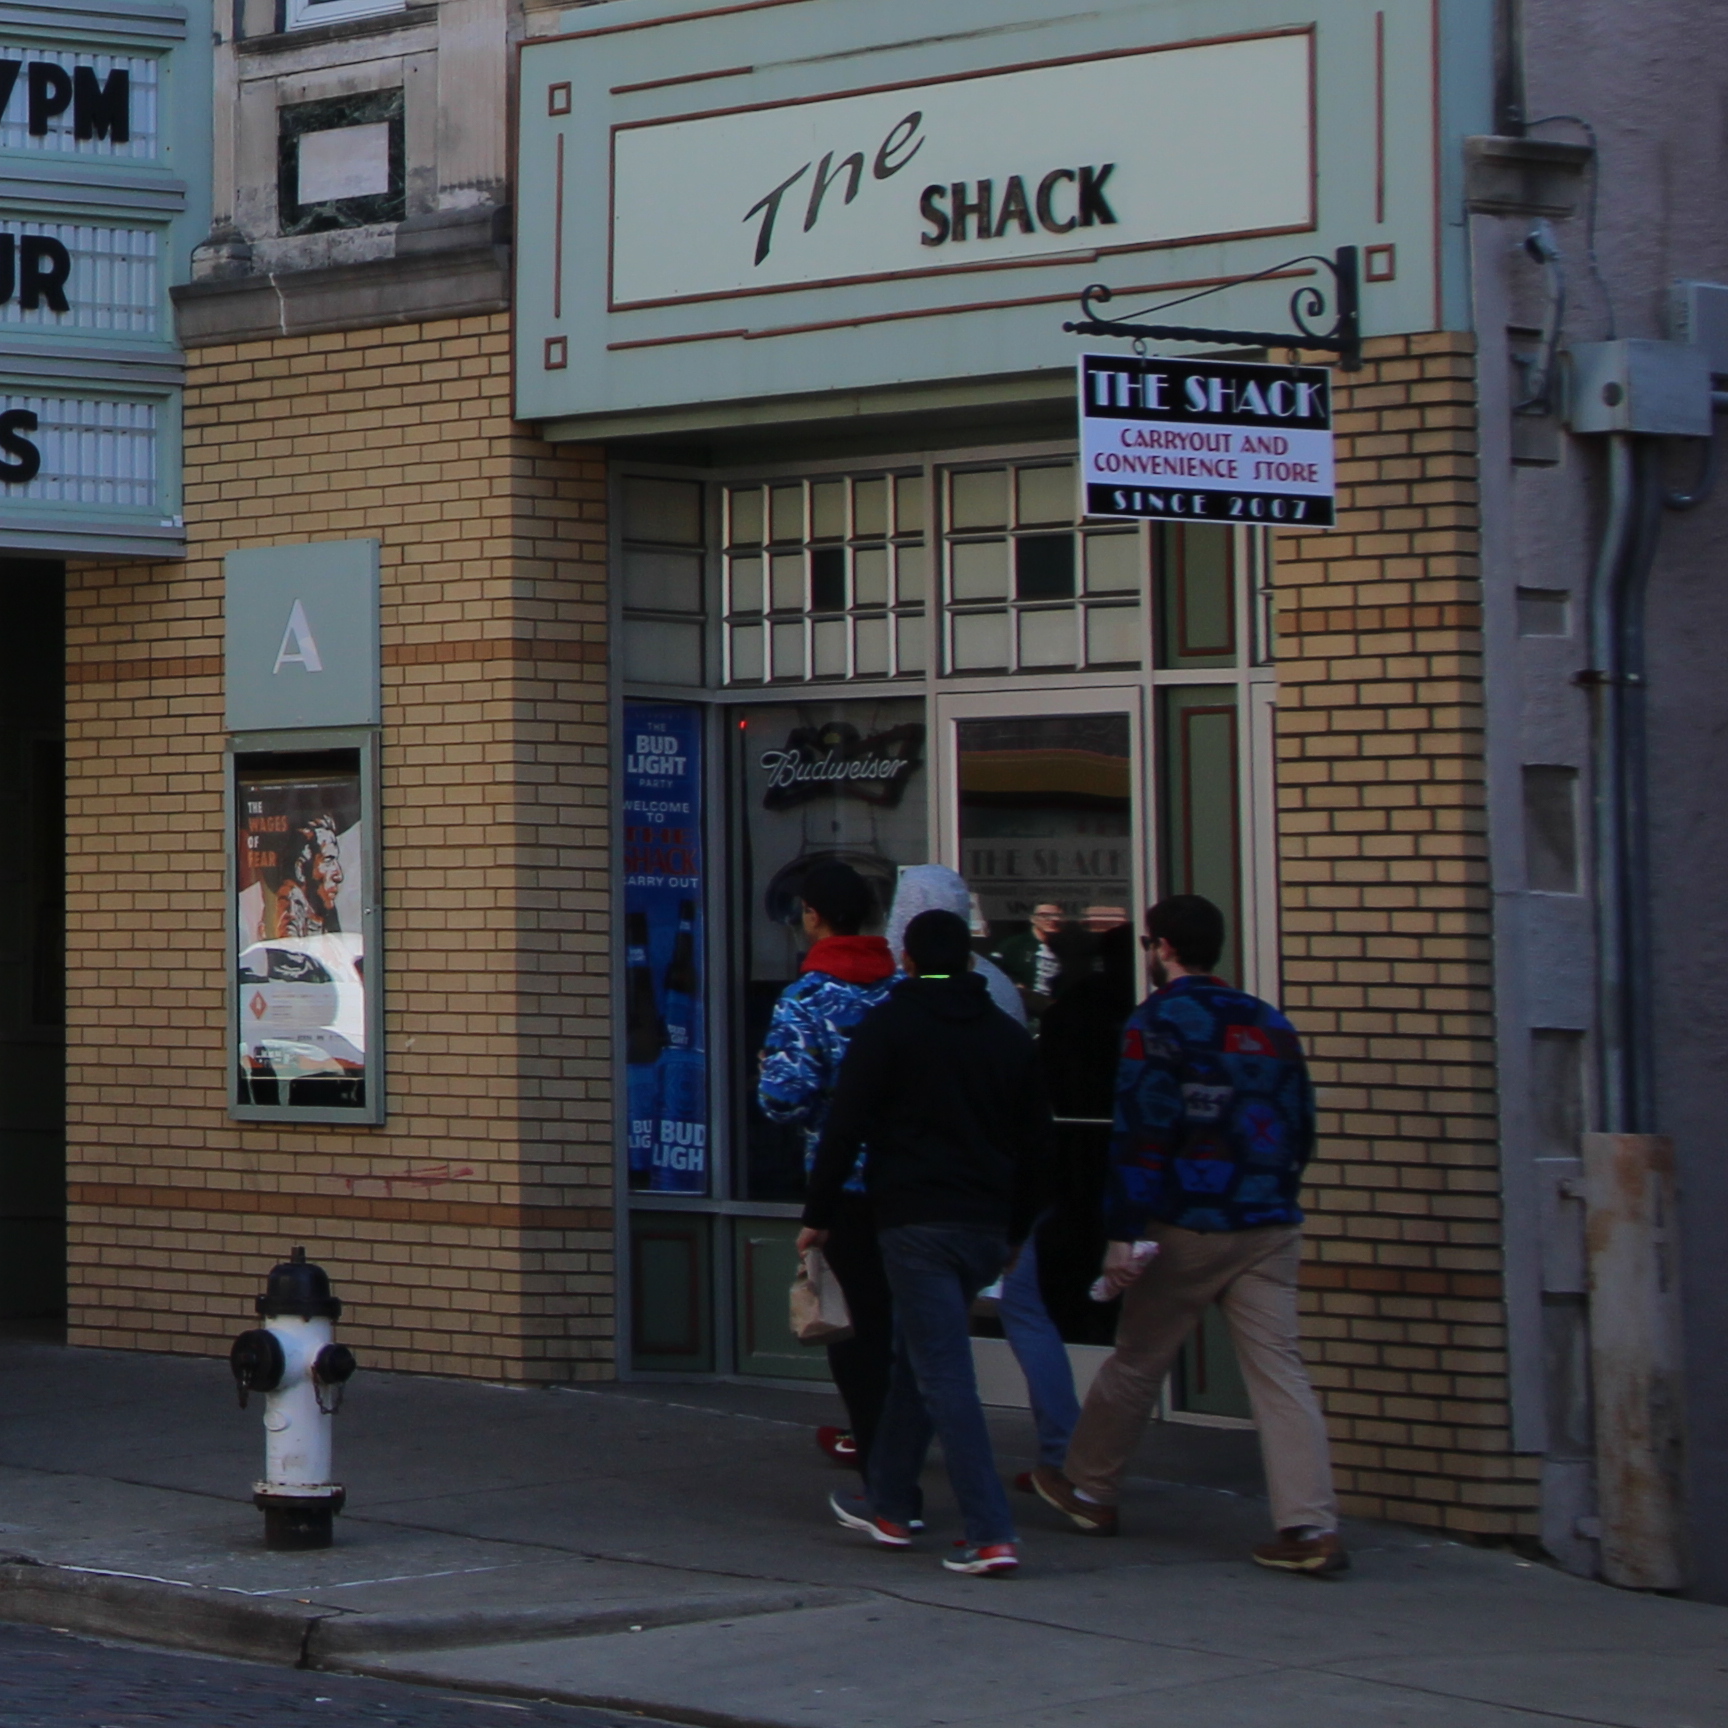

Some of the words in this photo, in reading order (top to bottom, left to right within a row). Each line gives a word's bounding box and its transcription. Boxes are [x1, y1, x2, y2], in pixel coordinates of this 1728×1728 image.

[742, 109, 926, 267] The
[920, 162, 1117, 247] SHACK
[1088, 370, 1170, 410] THE
[1184, 375, 1325, 418] SHACK
[1121, 428, 1233, 453] CARRYOUT
[1240, 435, 1288, 456] AND
[1094, 452, 1238, 479] CONVENIENCE
[1253, 460, 1319, 482] STORE
[1113, 490, 1206, 514] SINCE
[1229, 497, 1307, 518] 2007
[273, 598, 323, 674] A
[636, 735, 678, 755] BUD
[627, 754, 686, 776] LIGHT
[760, 749, 908, 787] Budweiser
[248, 801, 263, 814] THE
[646, 812, 664, 823] TO
[248, 815, 289, 833] WAGES
[247, 835, 260, 849] OF
[248, 851, 277, 868] FEAR
[668, 877, 698, 888] OUT
